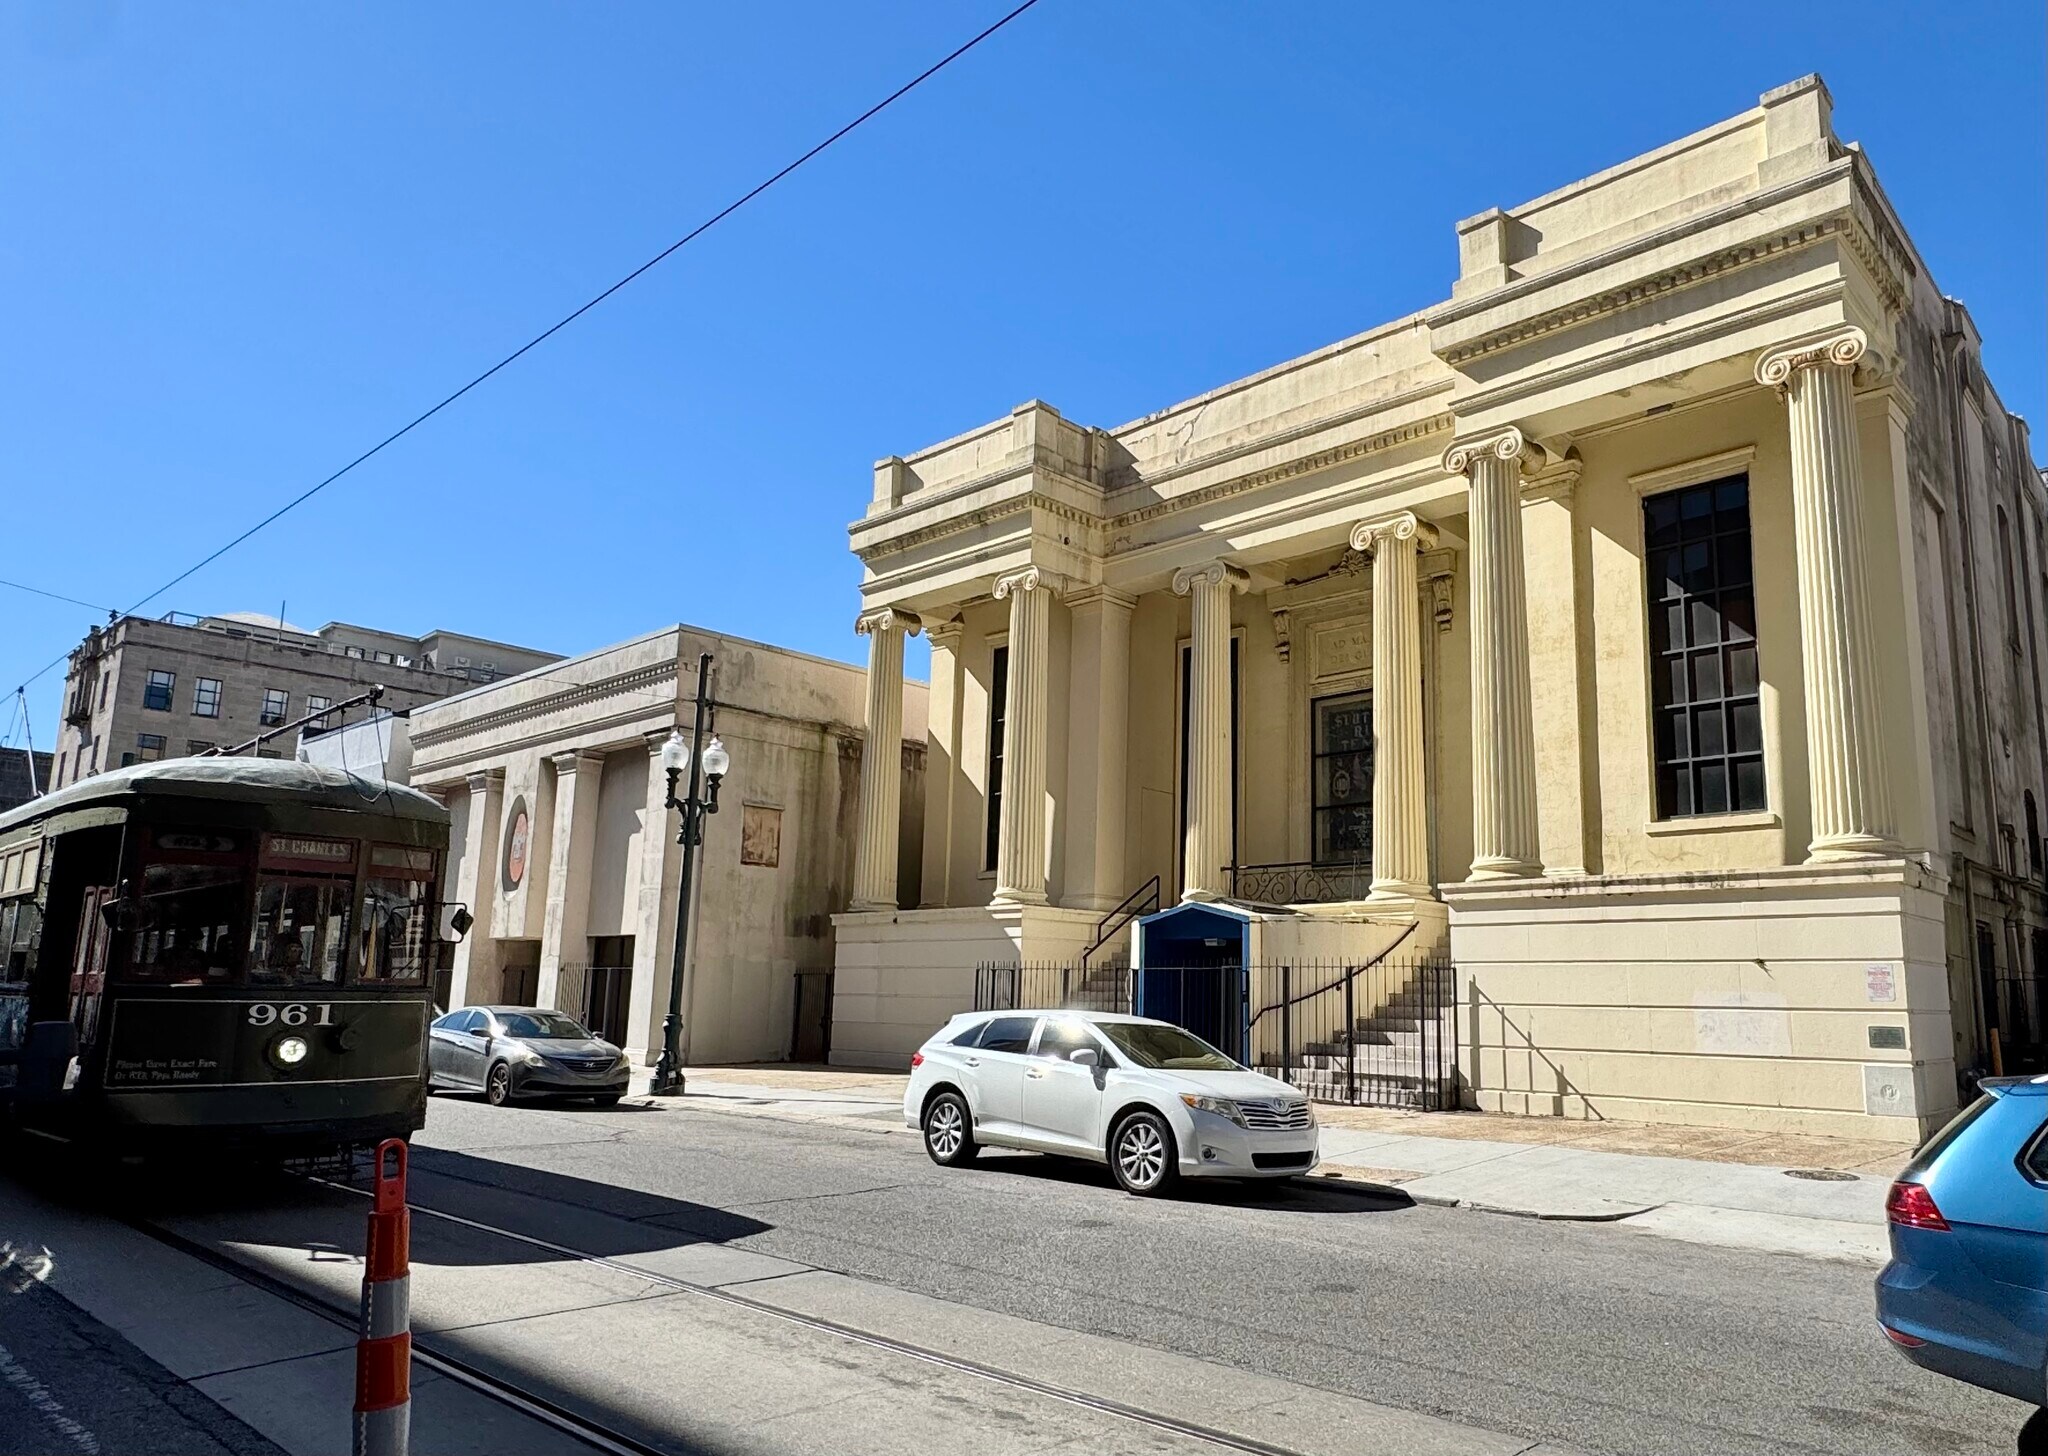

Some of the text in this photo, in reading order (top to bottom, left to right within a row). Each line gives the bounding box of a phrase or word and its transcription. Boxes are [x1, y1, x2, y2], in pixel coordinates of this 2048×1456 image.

[292, 839, 347, 857] CHARLES
[248, 1003, 335, 1026] 961
[170, 1058, 195, 1068] Exact
[197, 1058, 218, 1068] Fare
